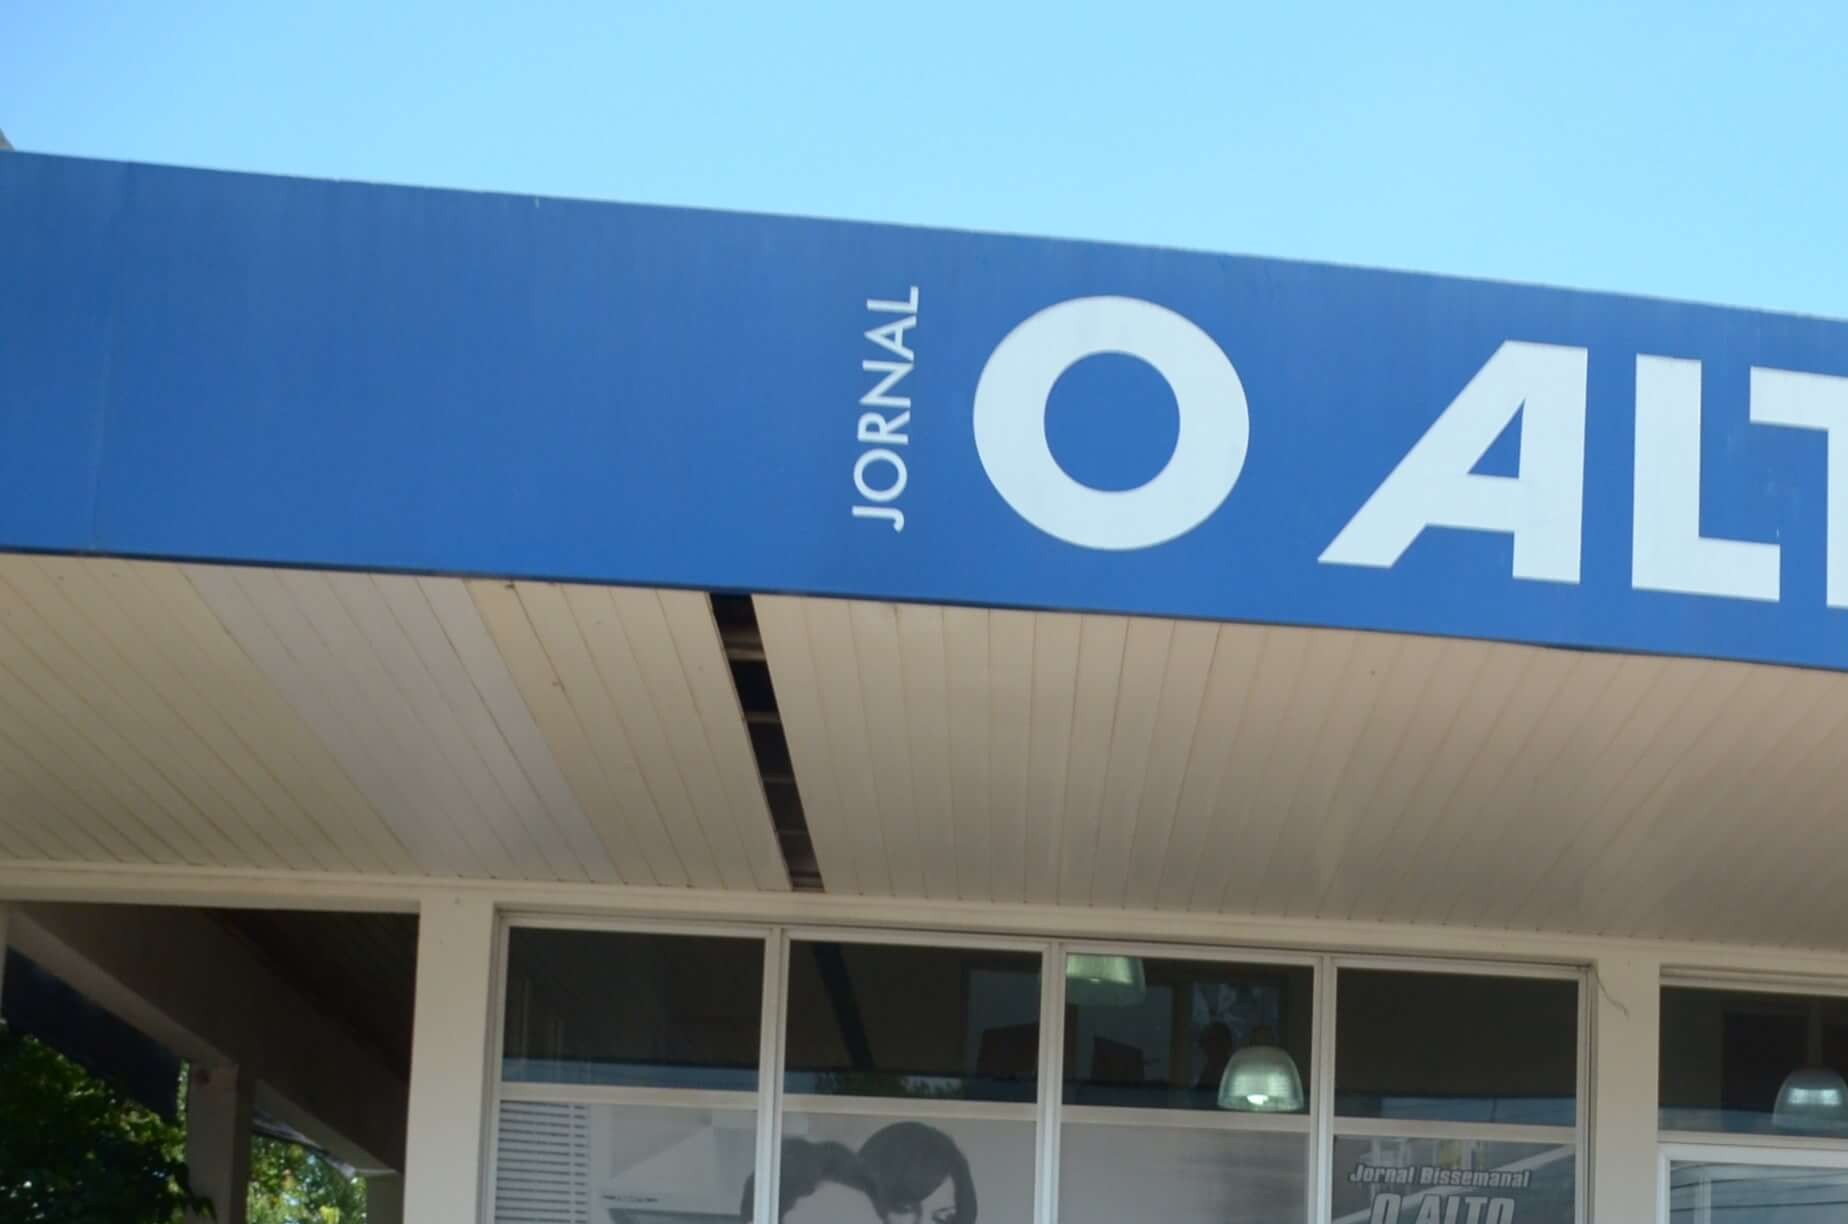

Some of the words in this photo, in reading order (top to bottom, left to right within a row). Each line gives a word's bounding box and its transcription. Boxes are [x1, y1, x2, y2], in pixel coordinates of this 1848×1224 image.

[850, 285, 920, 532] JORNAL
[972, 294, 1250, 551] O
[1350, 1164, 1415, 1184] Jornal
[1420, 1166, 1530, 1188] Bissemanal
